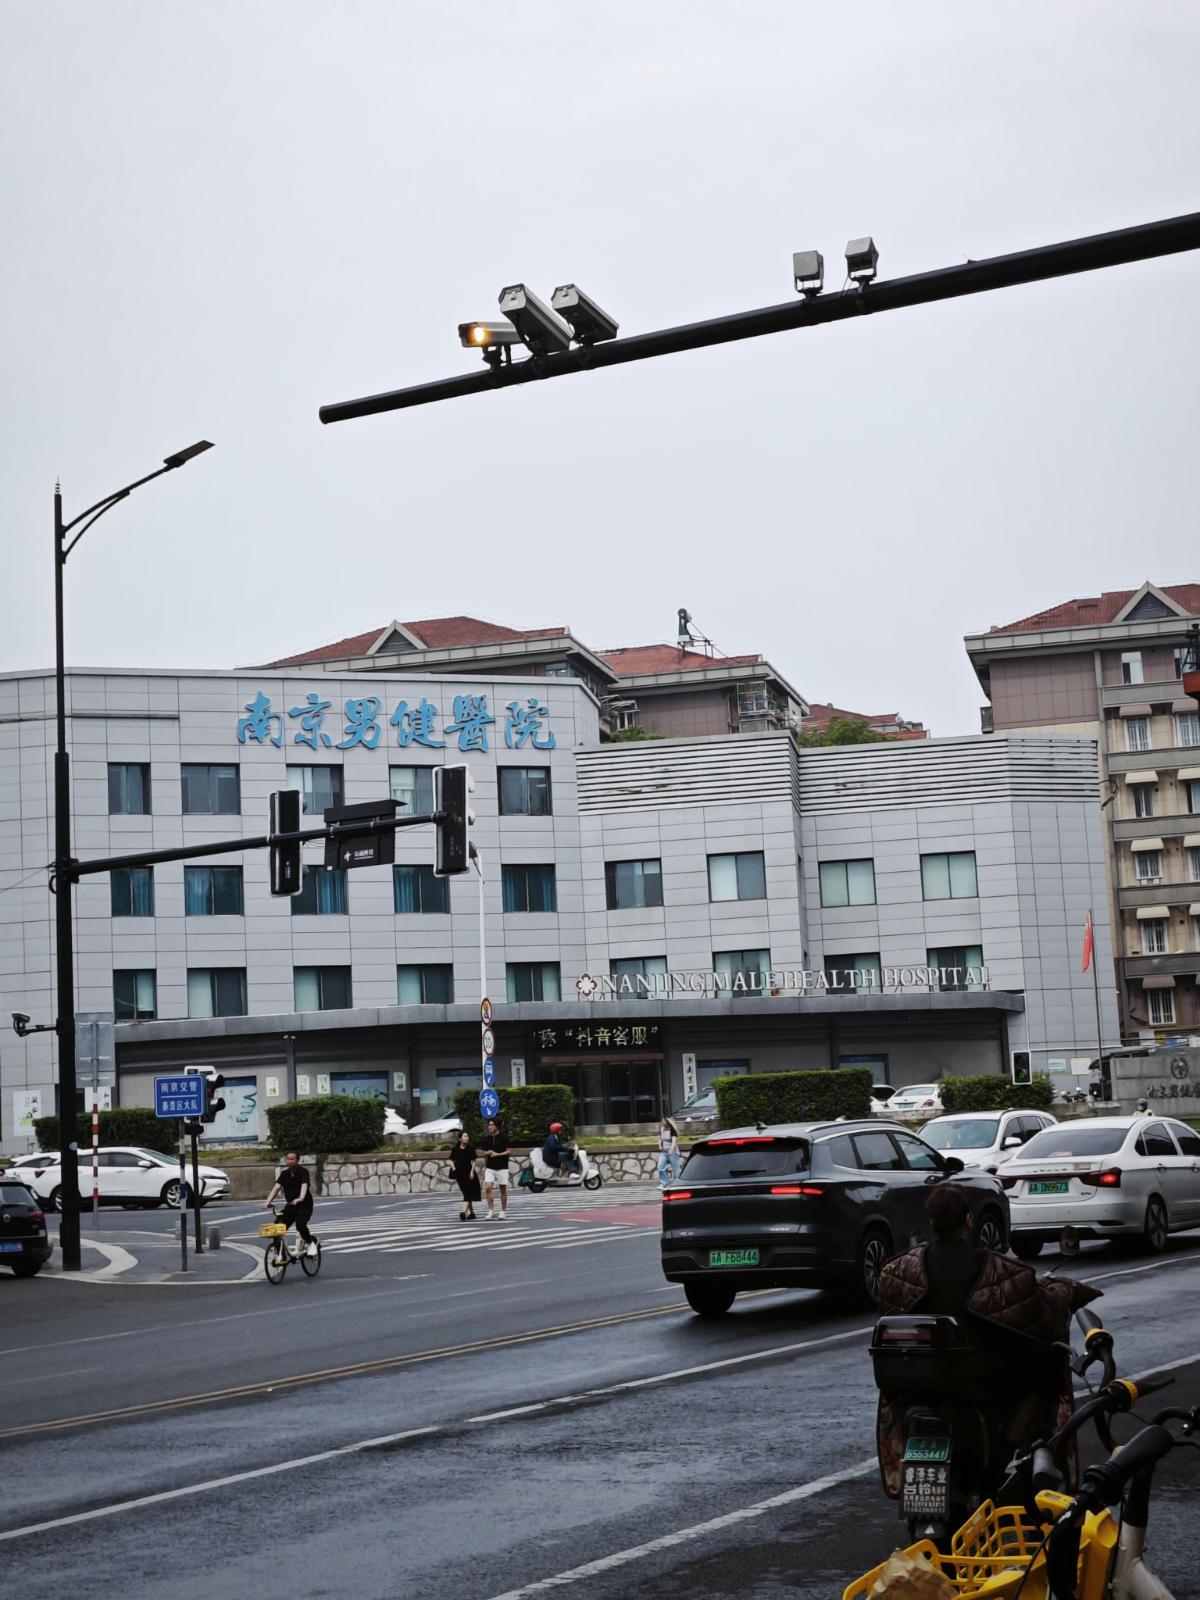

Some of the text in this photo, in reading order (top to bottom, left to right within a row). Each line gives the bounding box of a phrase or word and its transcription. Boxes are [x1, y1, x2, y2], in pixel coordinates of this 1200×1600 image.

[237, 690, 556, 753] 南京男健醫院
[601, 966, 992, 998] NANJING MALE HEALTH HOSPITAL
[160, 1080, 198, 1093] 南京交管
